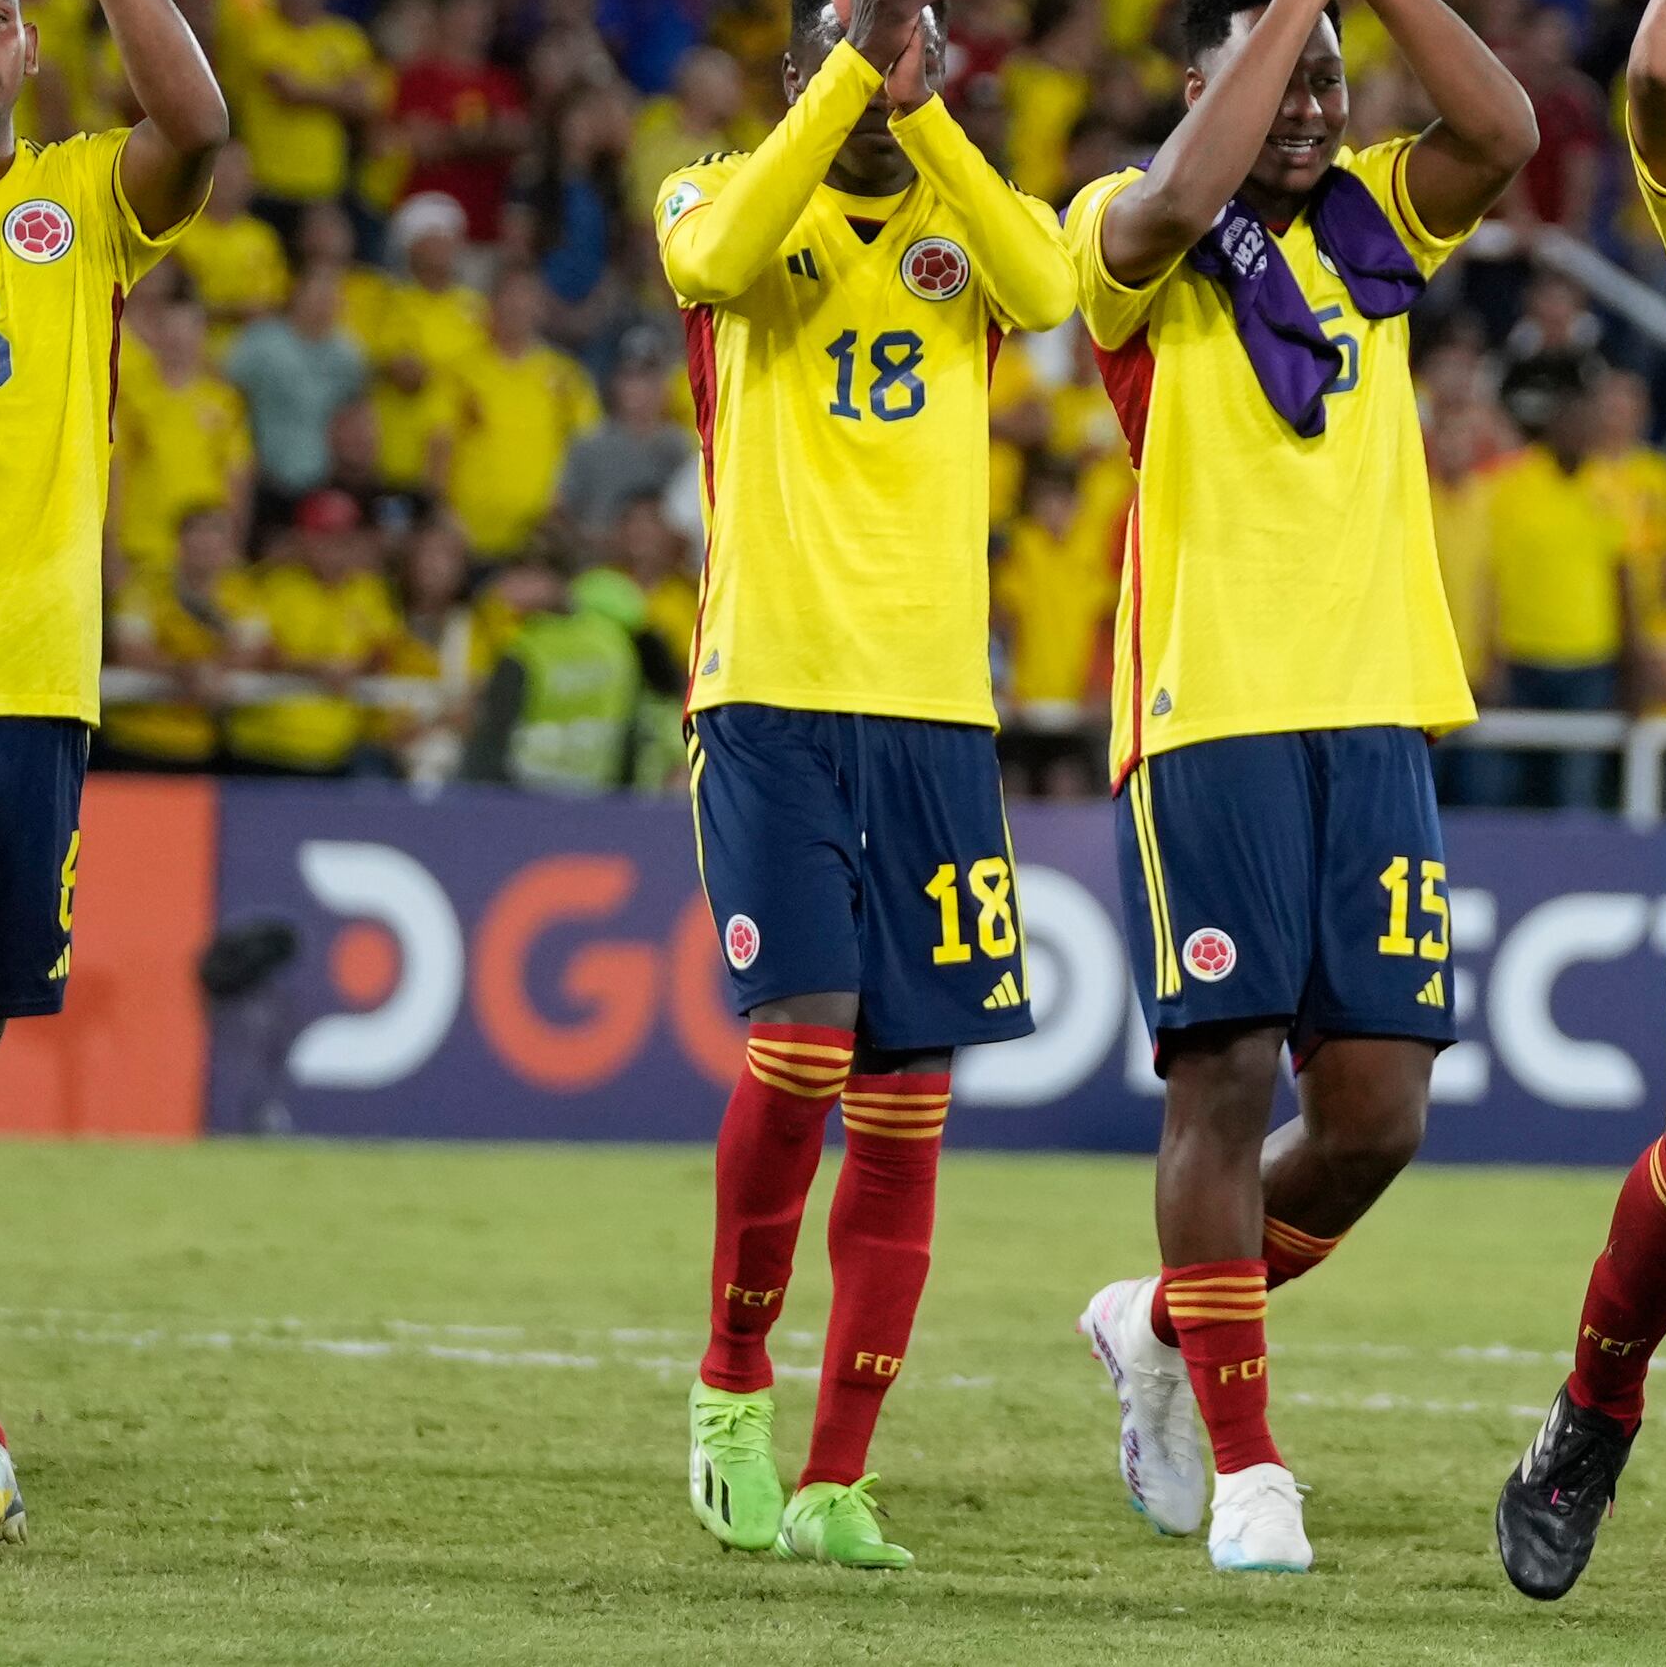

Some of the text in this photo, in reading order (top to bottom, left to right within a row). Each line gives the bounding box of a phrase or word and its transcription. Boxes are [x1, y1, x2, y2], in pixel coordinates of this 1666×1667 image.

[825, 329, 925, 422] 18
[925, 855, 1019, 967] 18
[1378, 856, 1450, 963] 15
[724, 1282, 784, 1308] FCF
